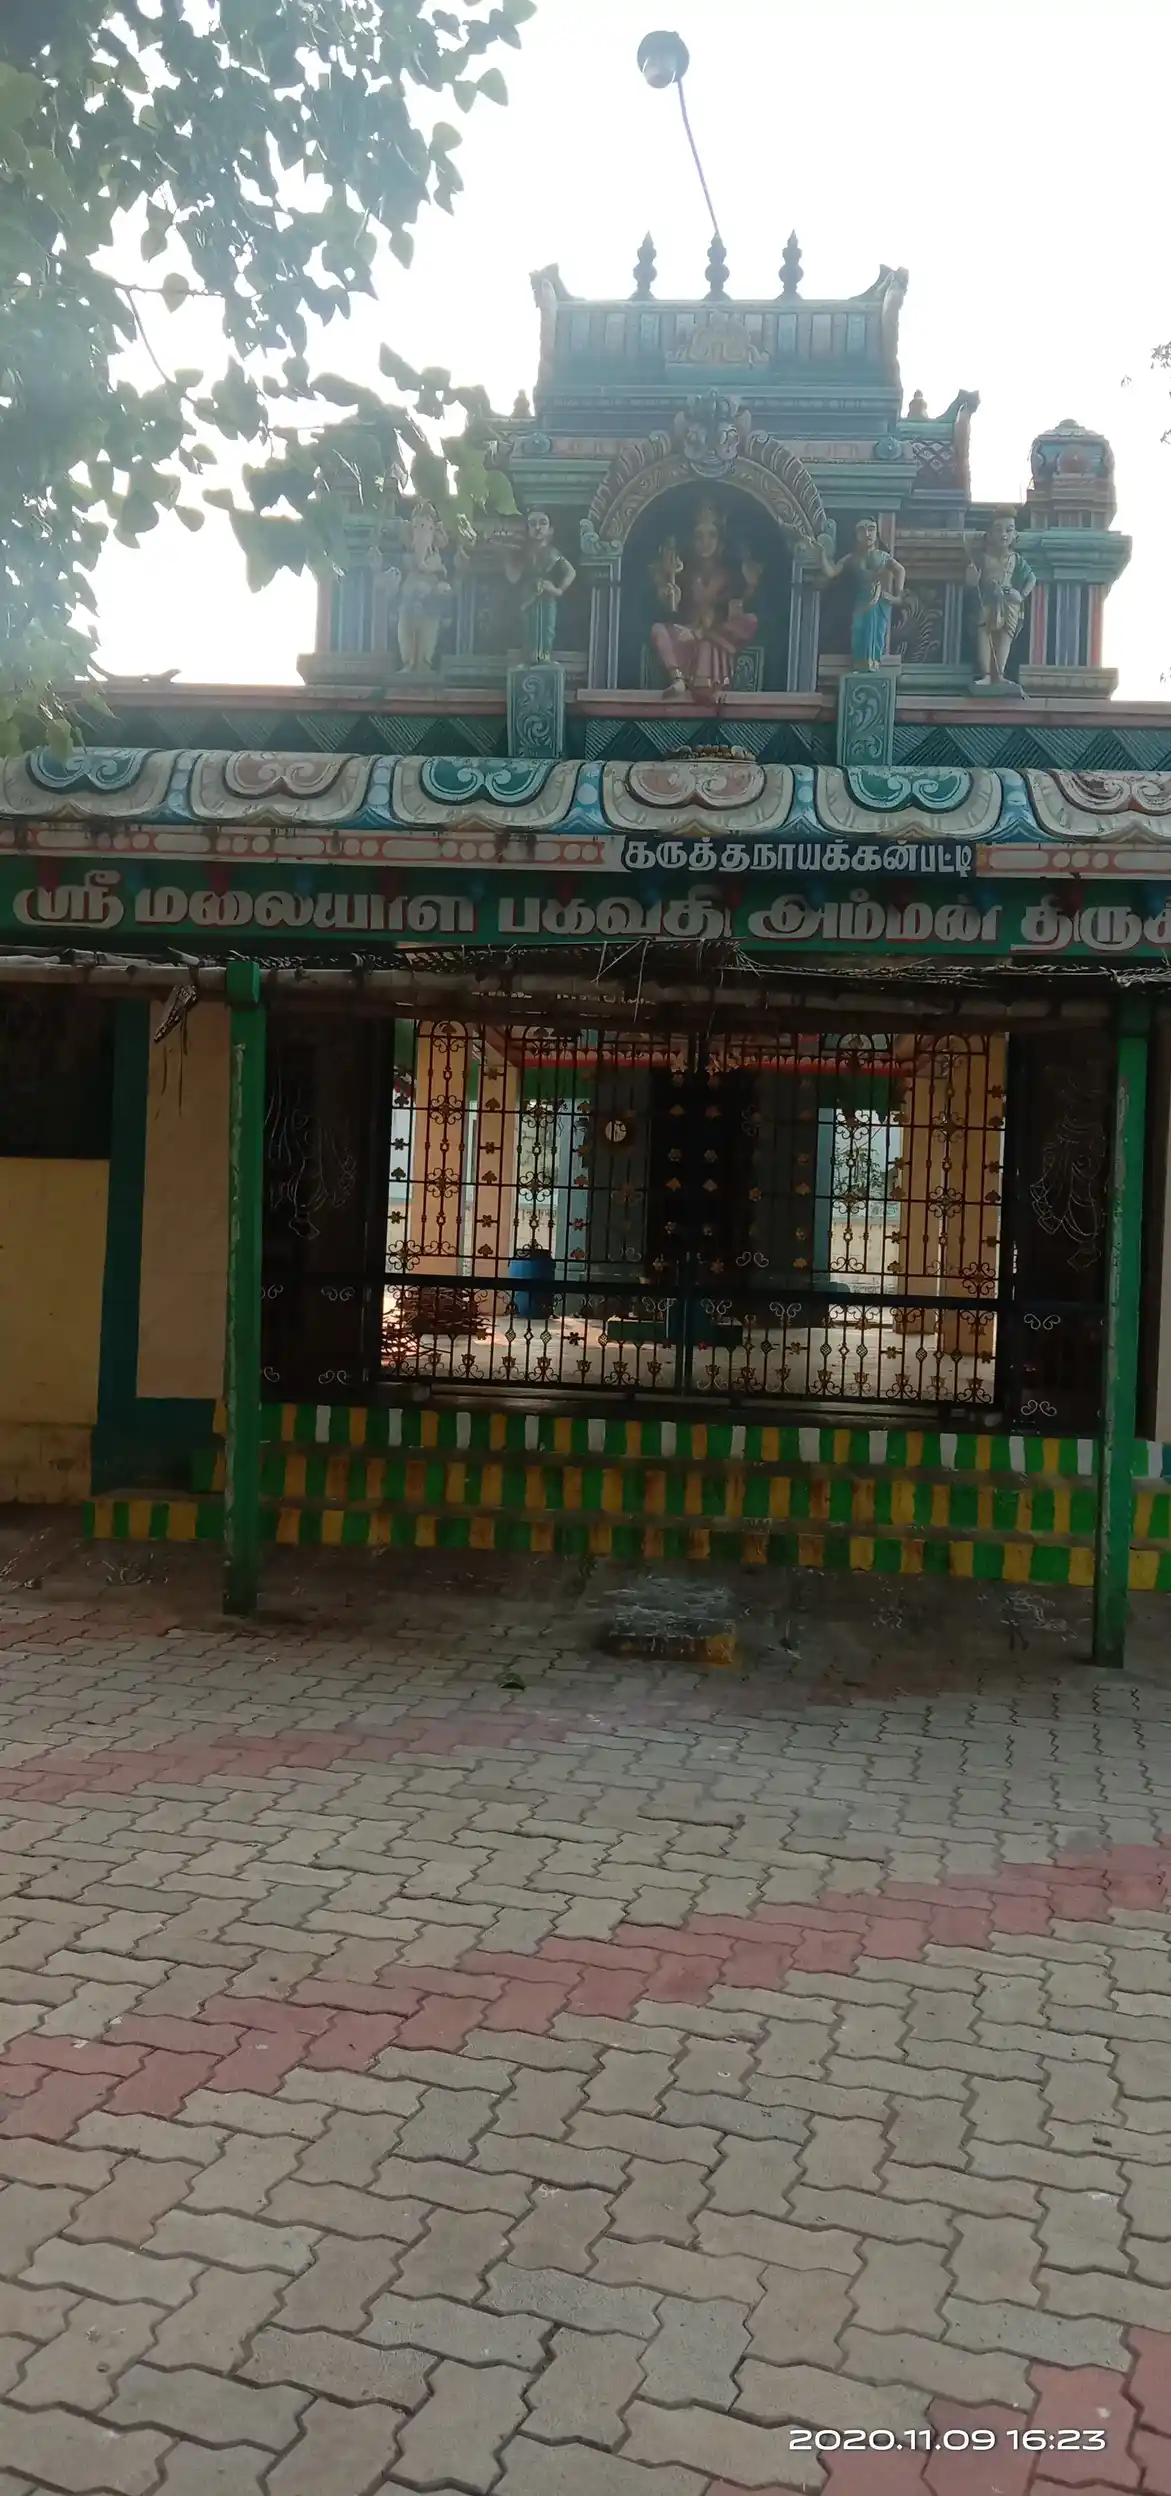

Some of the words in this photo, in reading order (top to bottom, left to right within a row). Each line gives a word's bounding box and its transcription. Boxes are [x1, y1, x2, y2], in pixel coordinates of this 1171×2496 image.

[625, 837, 973, 877] கருத்தநாயக்கன்பட்டி
[12, 870, 124, 930] ஸ்ரீ
[135, 885, 477, 933] மலையாள
[498, 884, 733, 939] பகவதி
[747, 886, 1003, 942] அம்மன்
